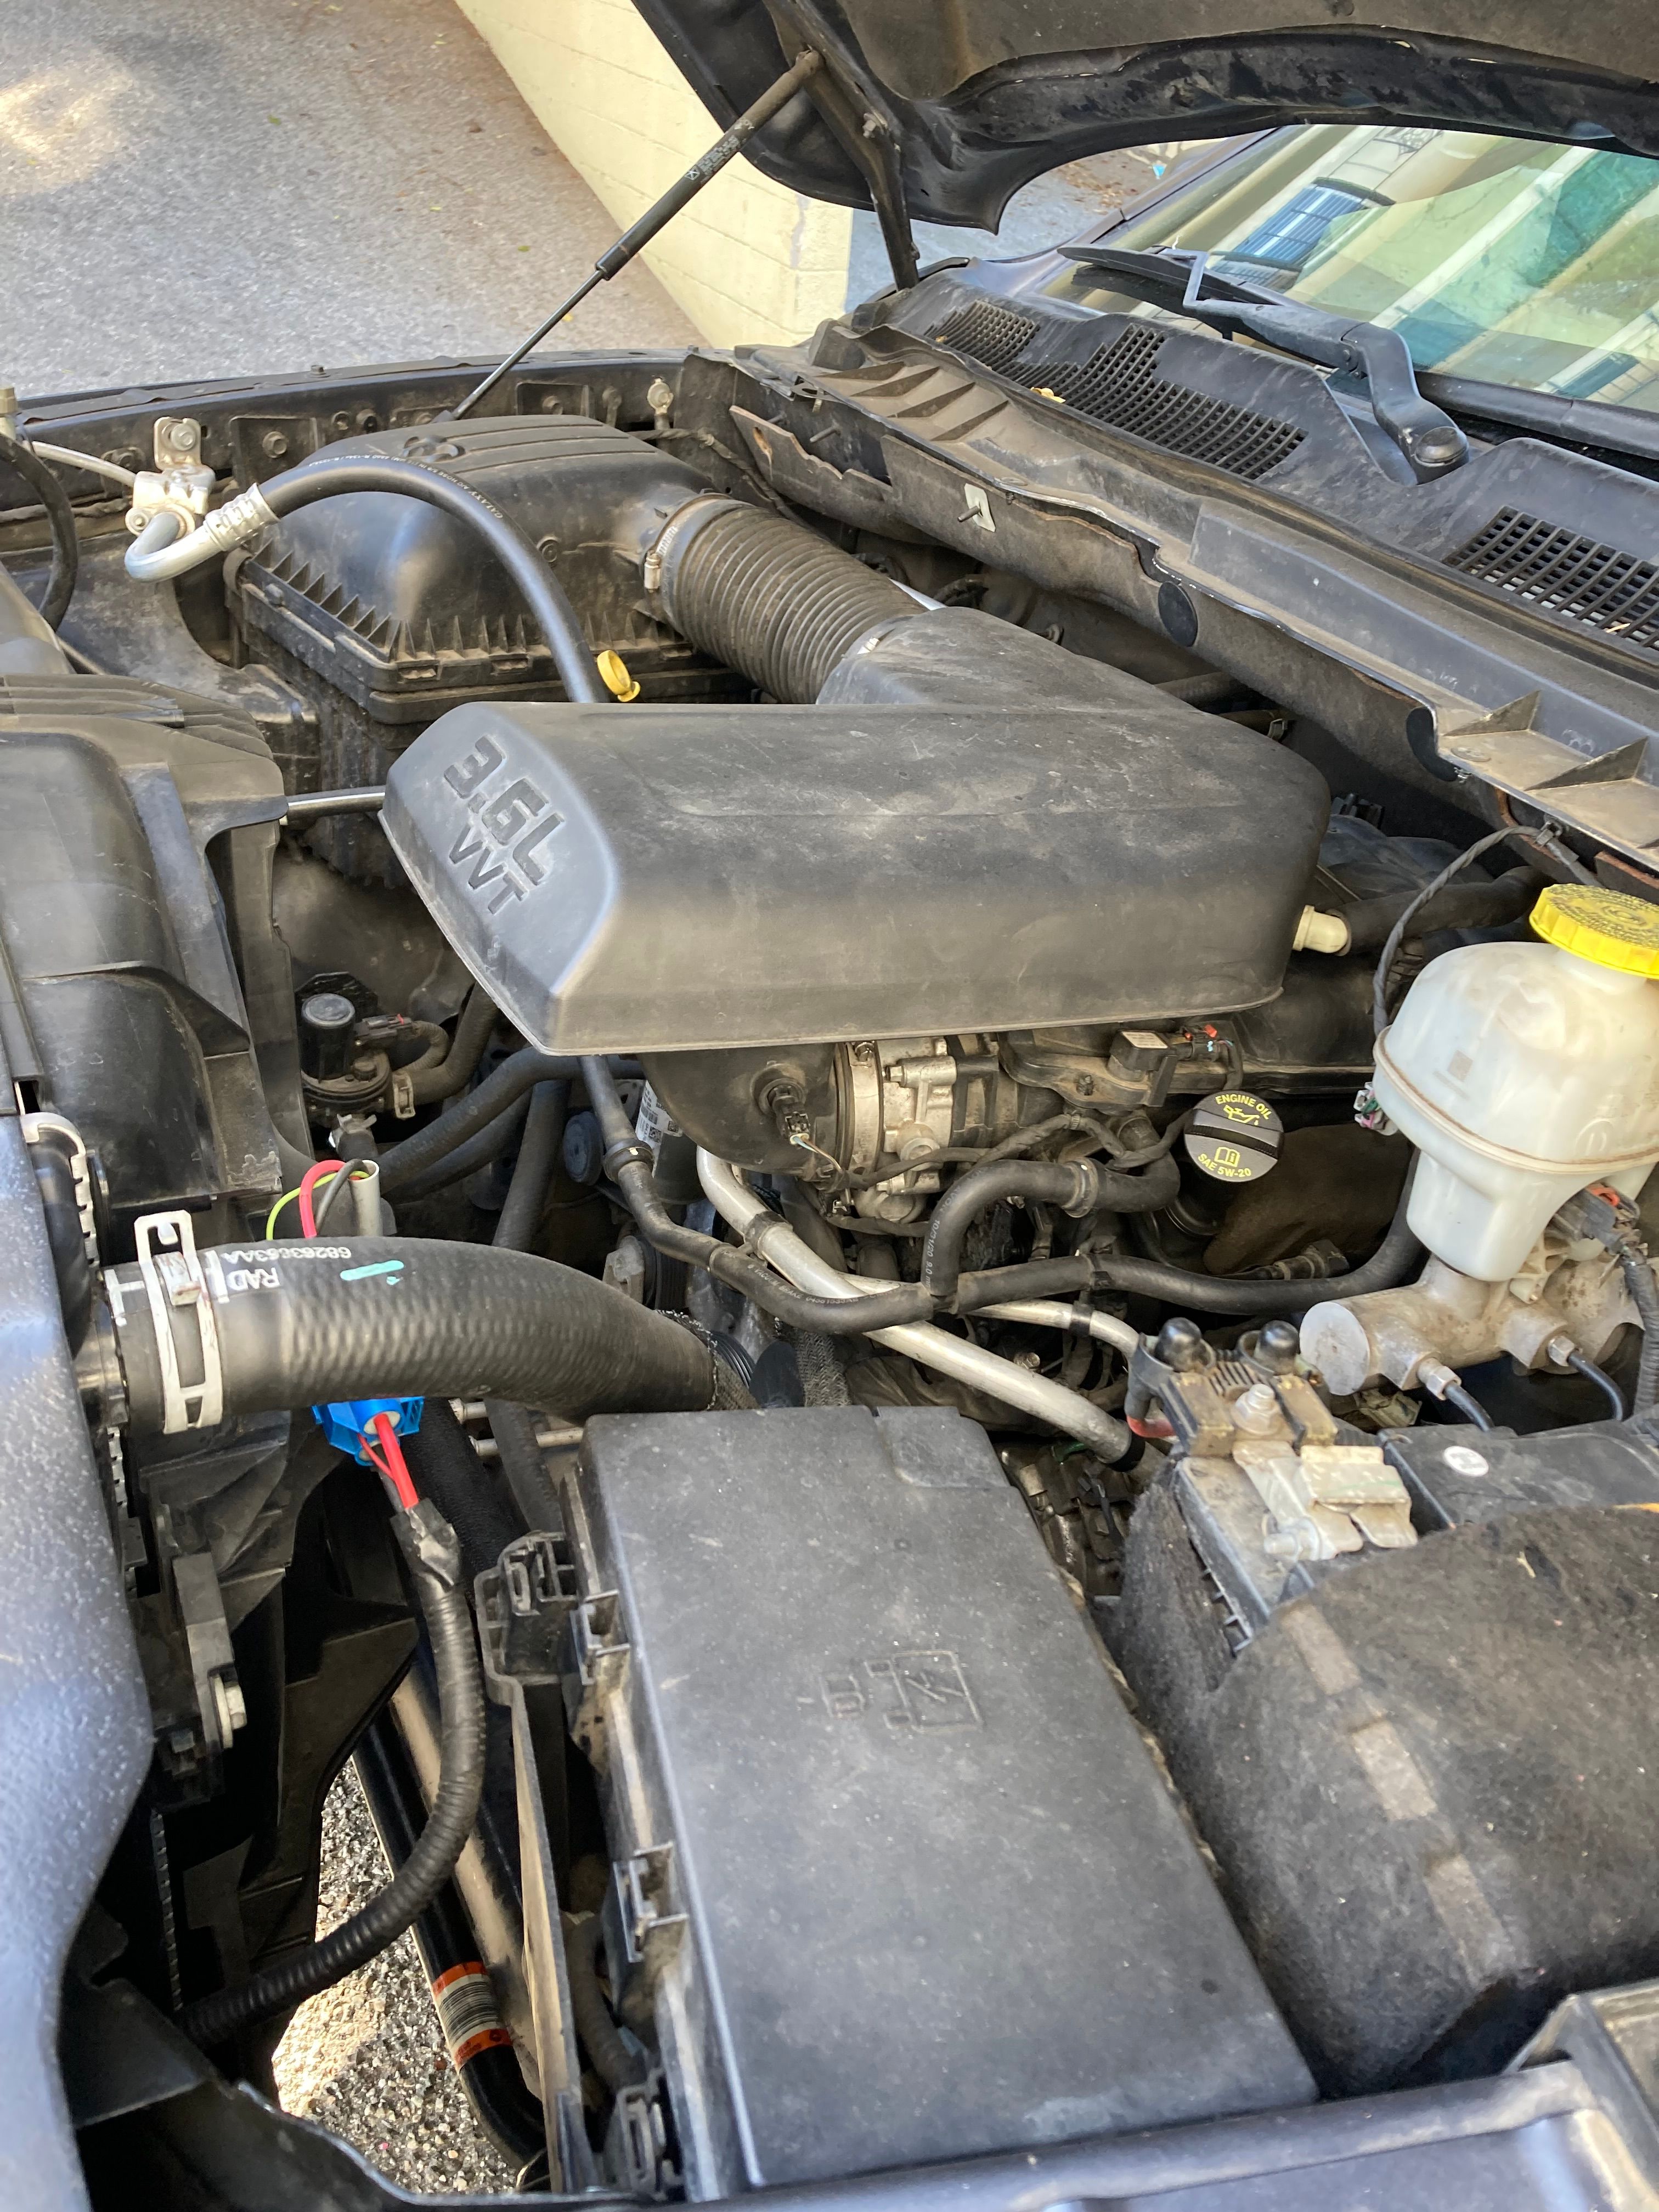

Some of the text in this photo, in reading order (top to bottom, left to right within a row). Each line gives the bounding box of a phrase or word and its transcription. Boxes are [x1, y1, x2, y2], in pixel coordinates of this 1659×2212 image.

[438, 471, 457, 483] HOSE
[468, 490, 503, 518] GALAXY
[443, 733, 566, 887] 3.6L
[448, 822, 530, 916] VVT
[1215, 1094, 1273, 1120] ENGINE OIL
[1198, 1153, 1252, 1178] SAE 5W-20
[927, 1219, 940, 1257] 10/31/20
[227, 1267, 281, 1291] RAD
